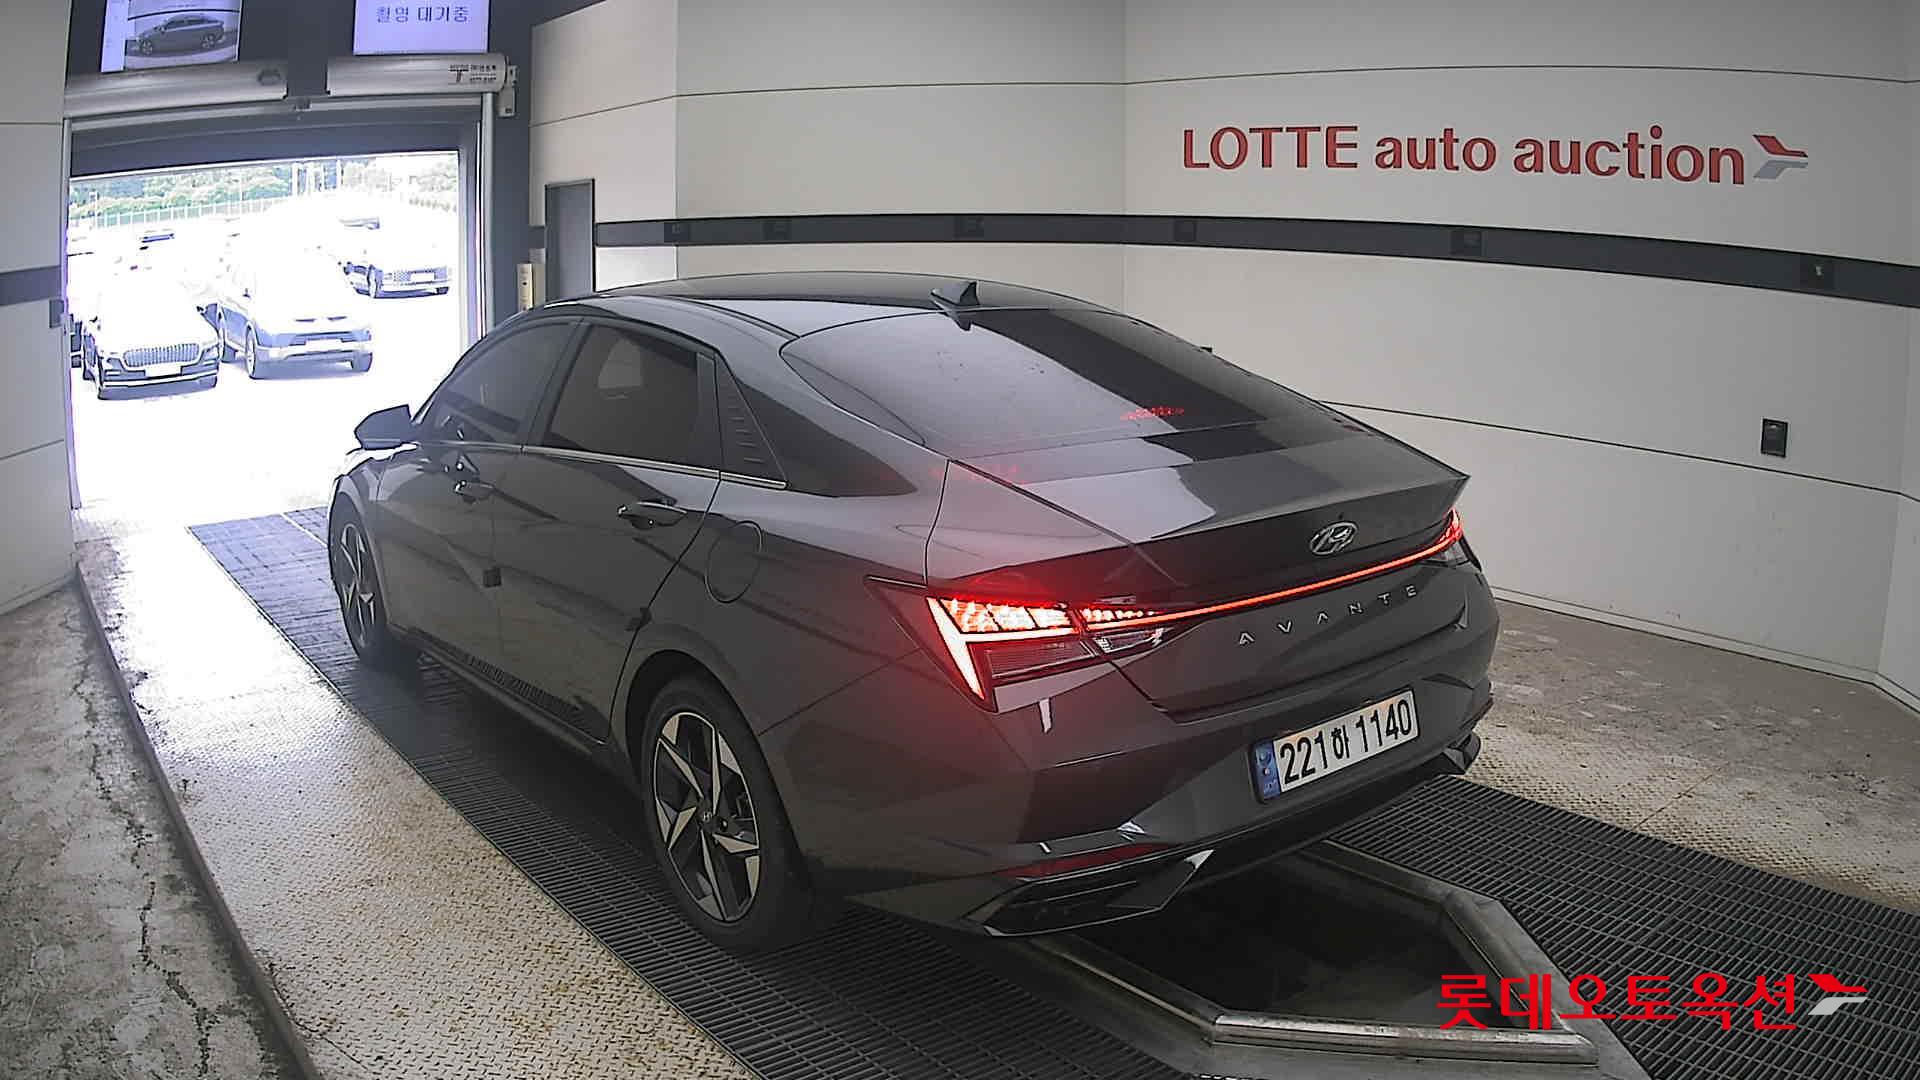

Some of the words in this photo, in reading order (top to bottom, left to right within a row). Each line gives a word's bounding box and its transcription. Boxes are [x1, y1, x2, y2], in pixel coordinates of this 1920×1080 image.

[417, 6, 470, 23] 대기중
[1183, 126, 1358, 170] LOTTE
[1375, 127, 1497, 172] auto
[1513, 125, 1746, 185] auction
[1238, 586, 1417, 645] AVANTE
[1280, 725, 1349, 784] 221하
[1356, 700, 1411, 752] 1140
